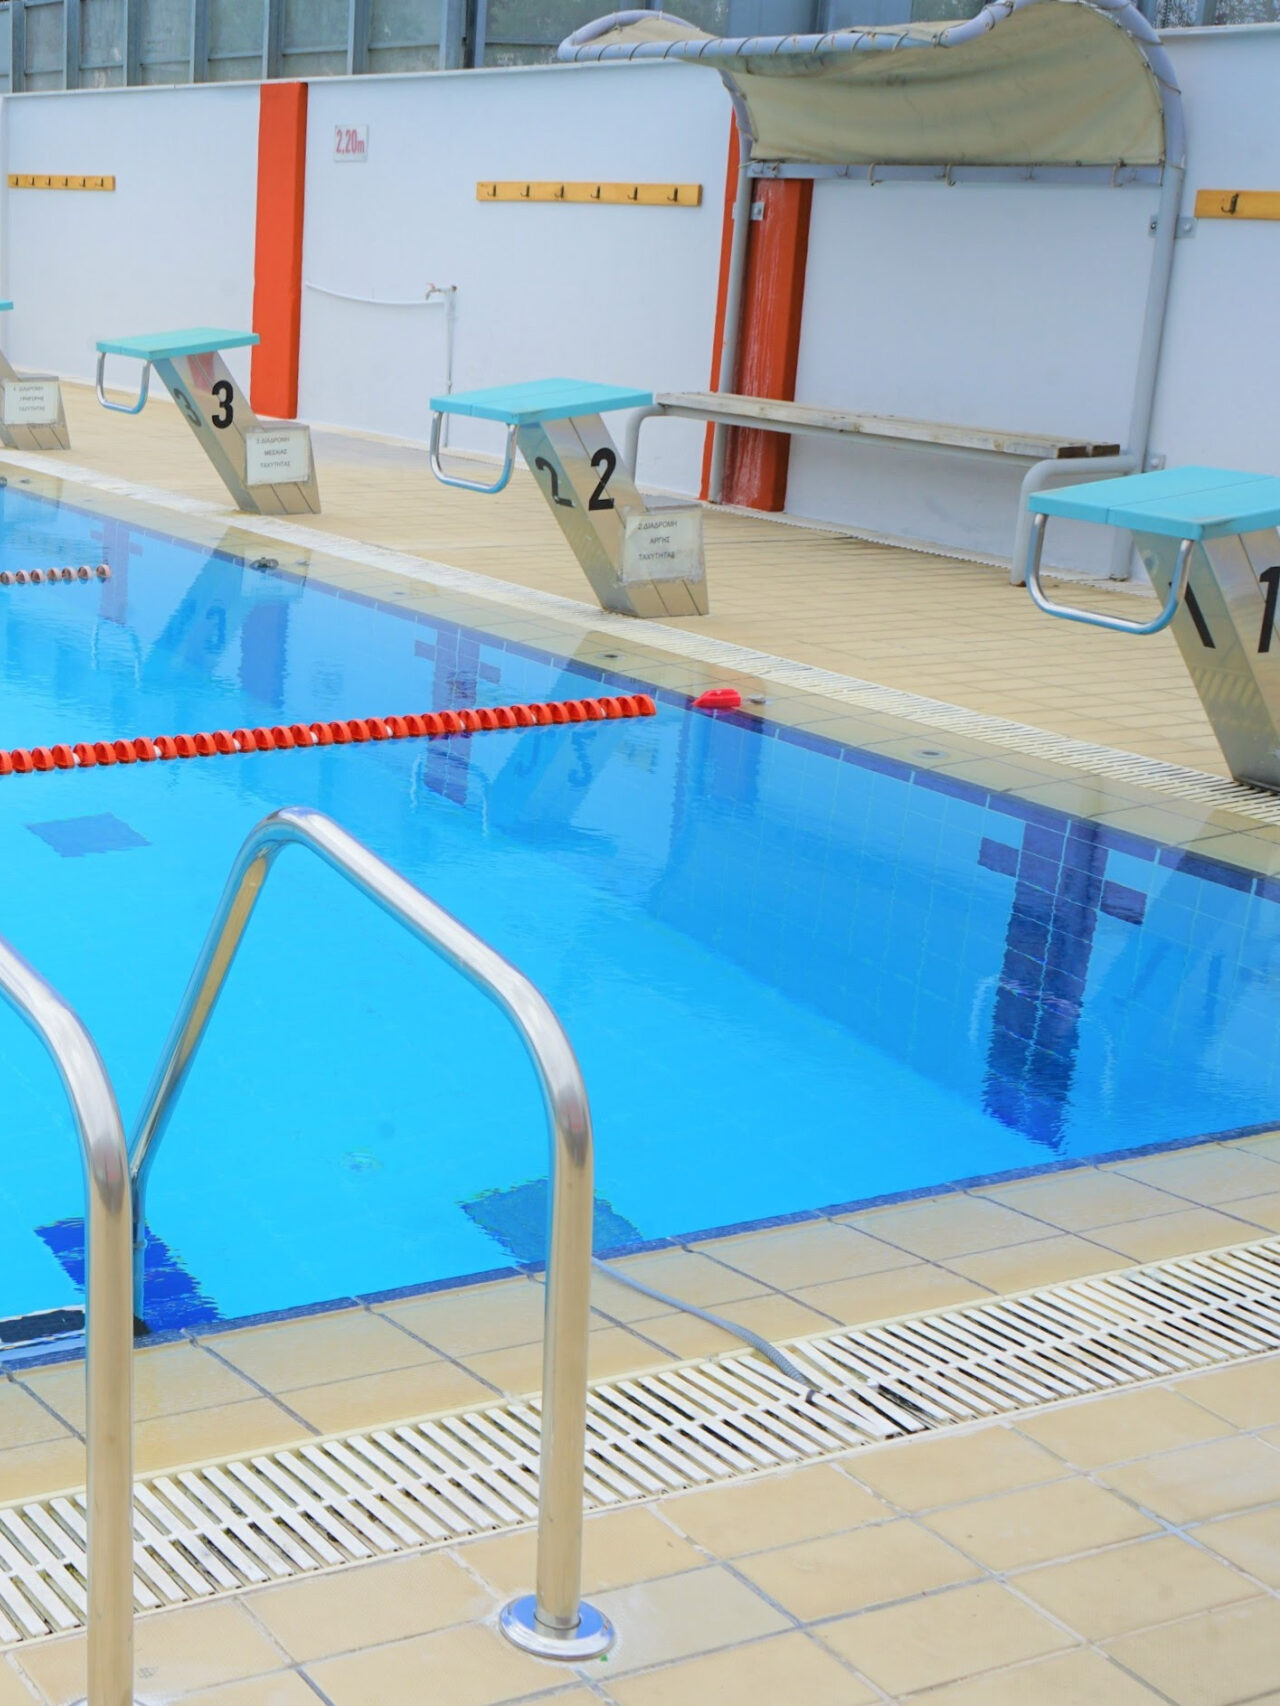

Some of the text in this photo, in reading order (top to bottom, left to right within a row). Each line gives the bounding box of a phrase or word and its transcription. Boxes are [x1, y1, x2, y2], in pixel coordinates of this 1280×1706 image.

[173, 388, 202, 428] 3
[211, 380, 234, 430] 3
[535, 456, 575, 508] 2
[588, 447, 616, 512] 2
[1257, 566, 1280, 654] 1
